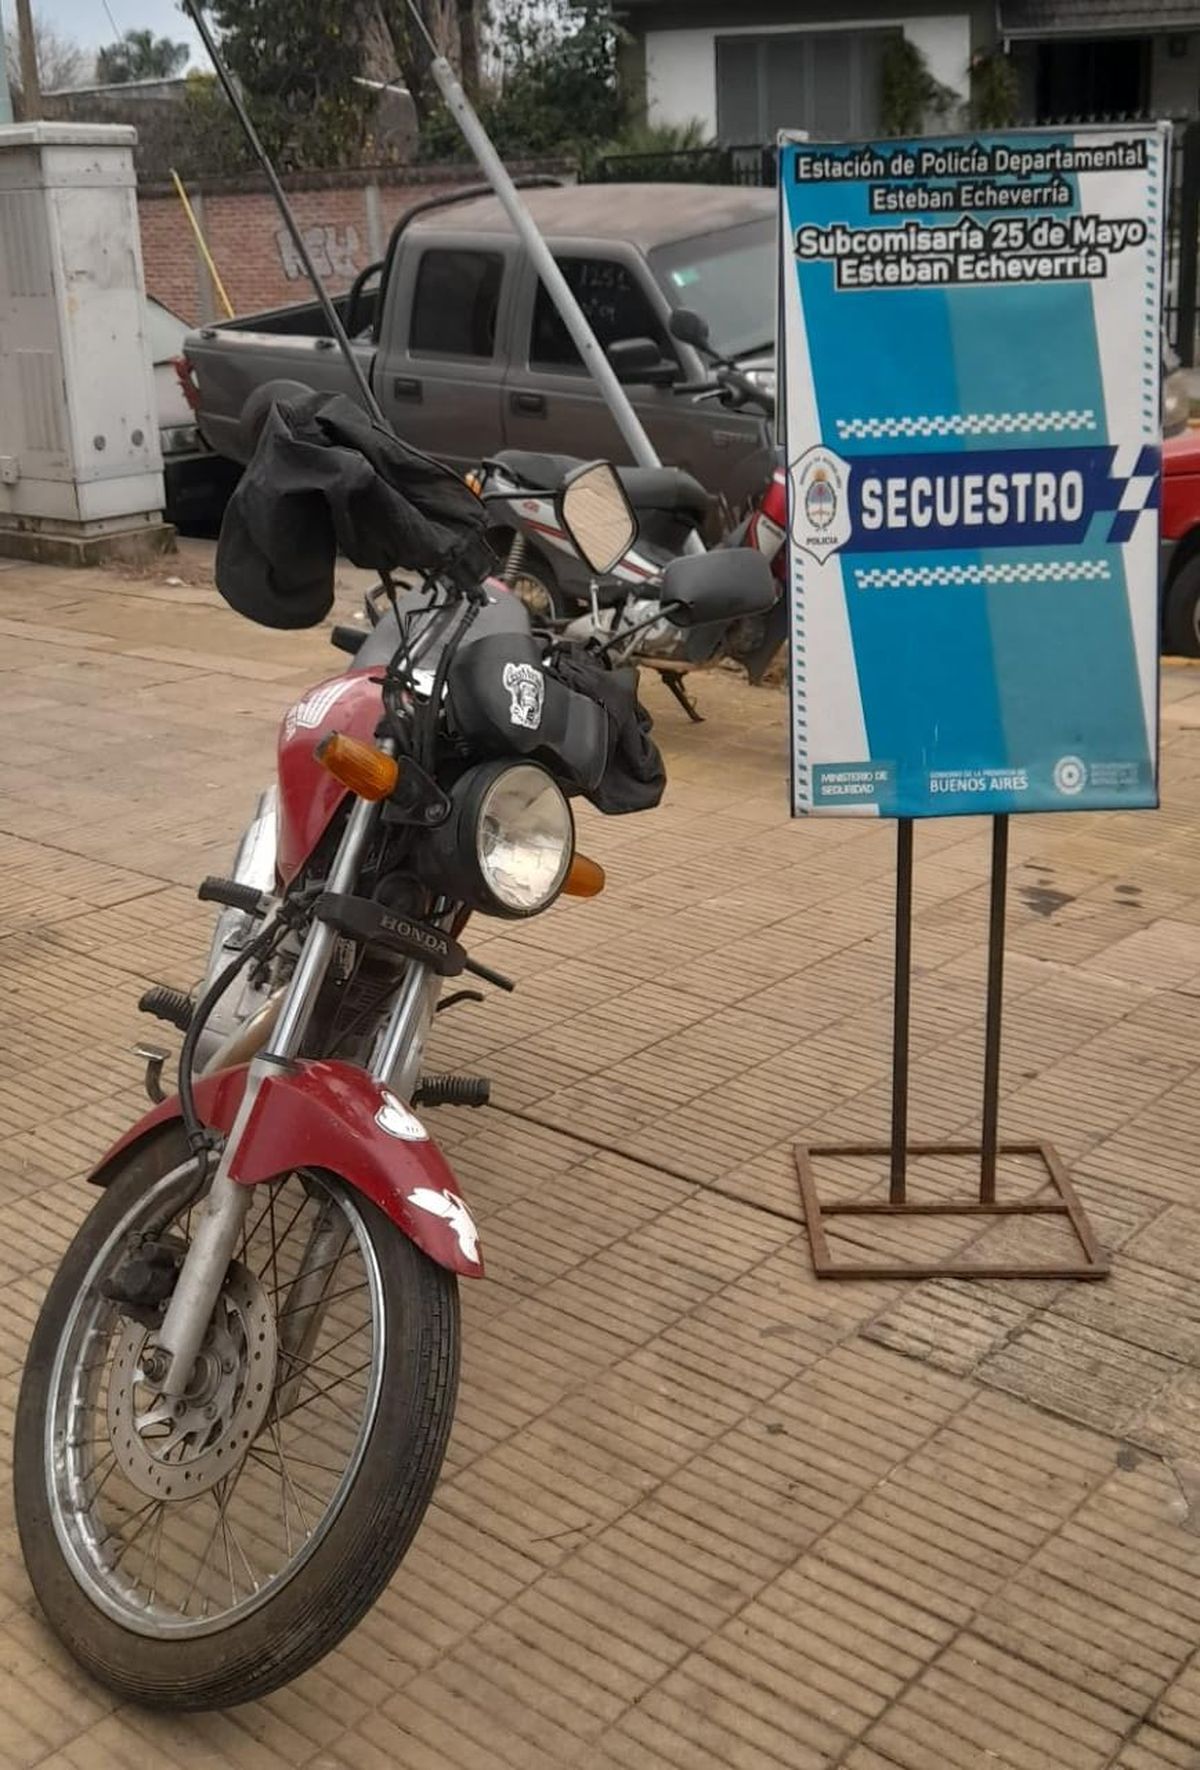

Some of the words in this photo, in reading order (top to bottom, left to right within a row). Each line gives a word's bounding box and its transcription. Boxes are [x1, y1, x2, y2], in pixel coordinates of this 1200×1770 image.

[798, 152, 885, 180] Estación
[890, 154, 915, 175] de
[921, 149, 989, 175] Policía
[994, 144, 1143, 176] Departamental
[872, 186, 954, 211] Esteban
[960, 179, 1069, 207] Echeverría
[799, 221, 984, 256] Subcomisaría
[991, 220, 1024, 249] 25
[1031, 216, 1066, 247] de
[1073, 218, 1145, 249] Mayo
[840, 255, 949, 285] Esteban
[957, 249, 1102, 281] Echeverría
[861, 470, 1084, 530] SECUESTRO
[821, 772, 873, 784] MINISTERIO
[874, 770, 889, 781] DE
[929, 777, 987, 793] BUENOS
[989, 775, 1029, 791] AIRES
[379, 915, 450, 955] HONDA
